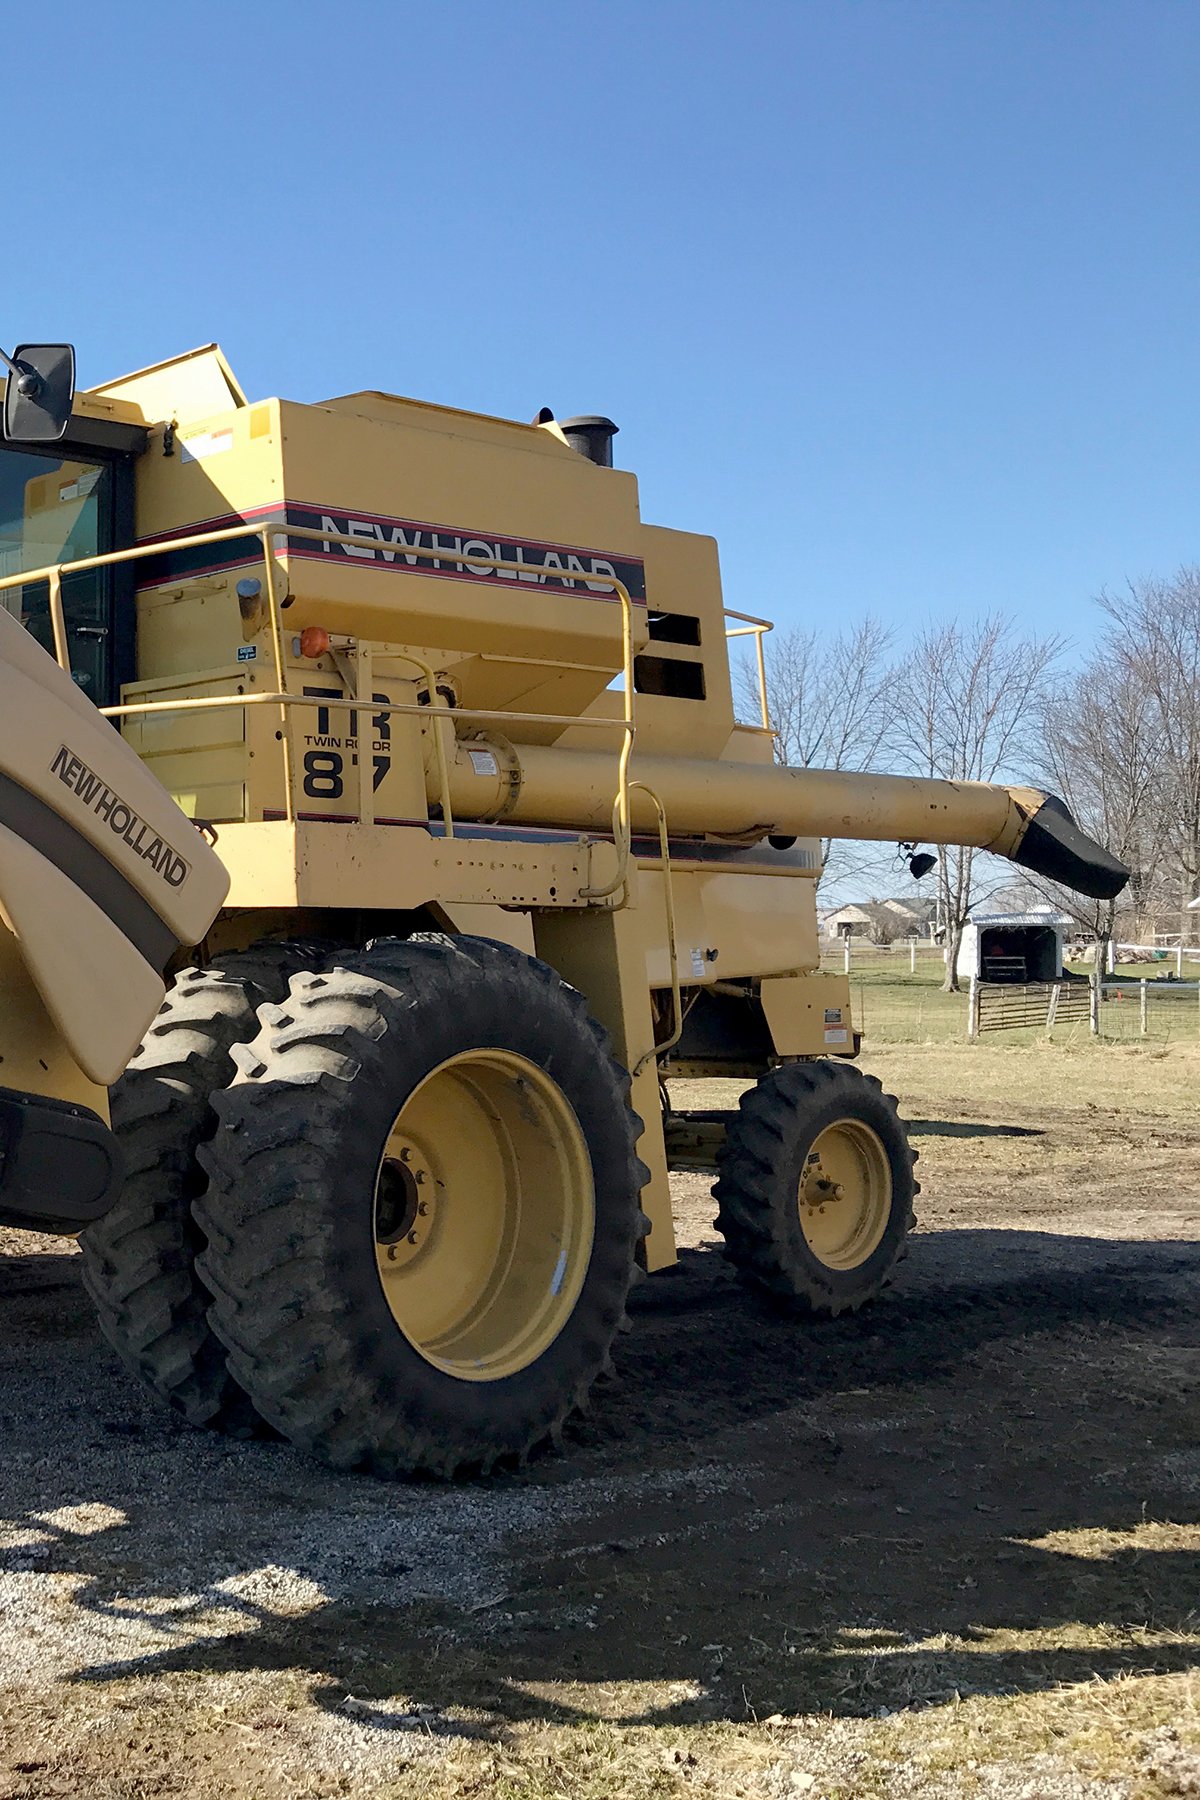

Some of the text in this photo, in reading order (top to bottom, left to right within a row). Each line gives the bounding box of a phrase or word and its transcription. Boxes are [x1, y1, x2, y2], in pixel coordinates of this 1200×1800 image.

[321, 515, 617, 593] NEW HOLLAND
[303, 750, 391, 799] 87
[304, 735, 391, 752] TWIN ROR
[50, 748, 187, 887] NEW HOLLAND
